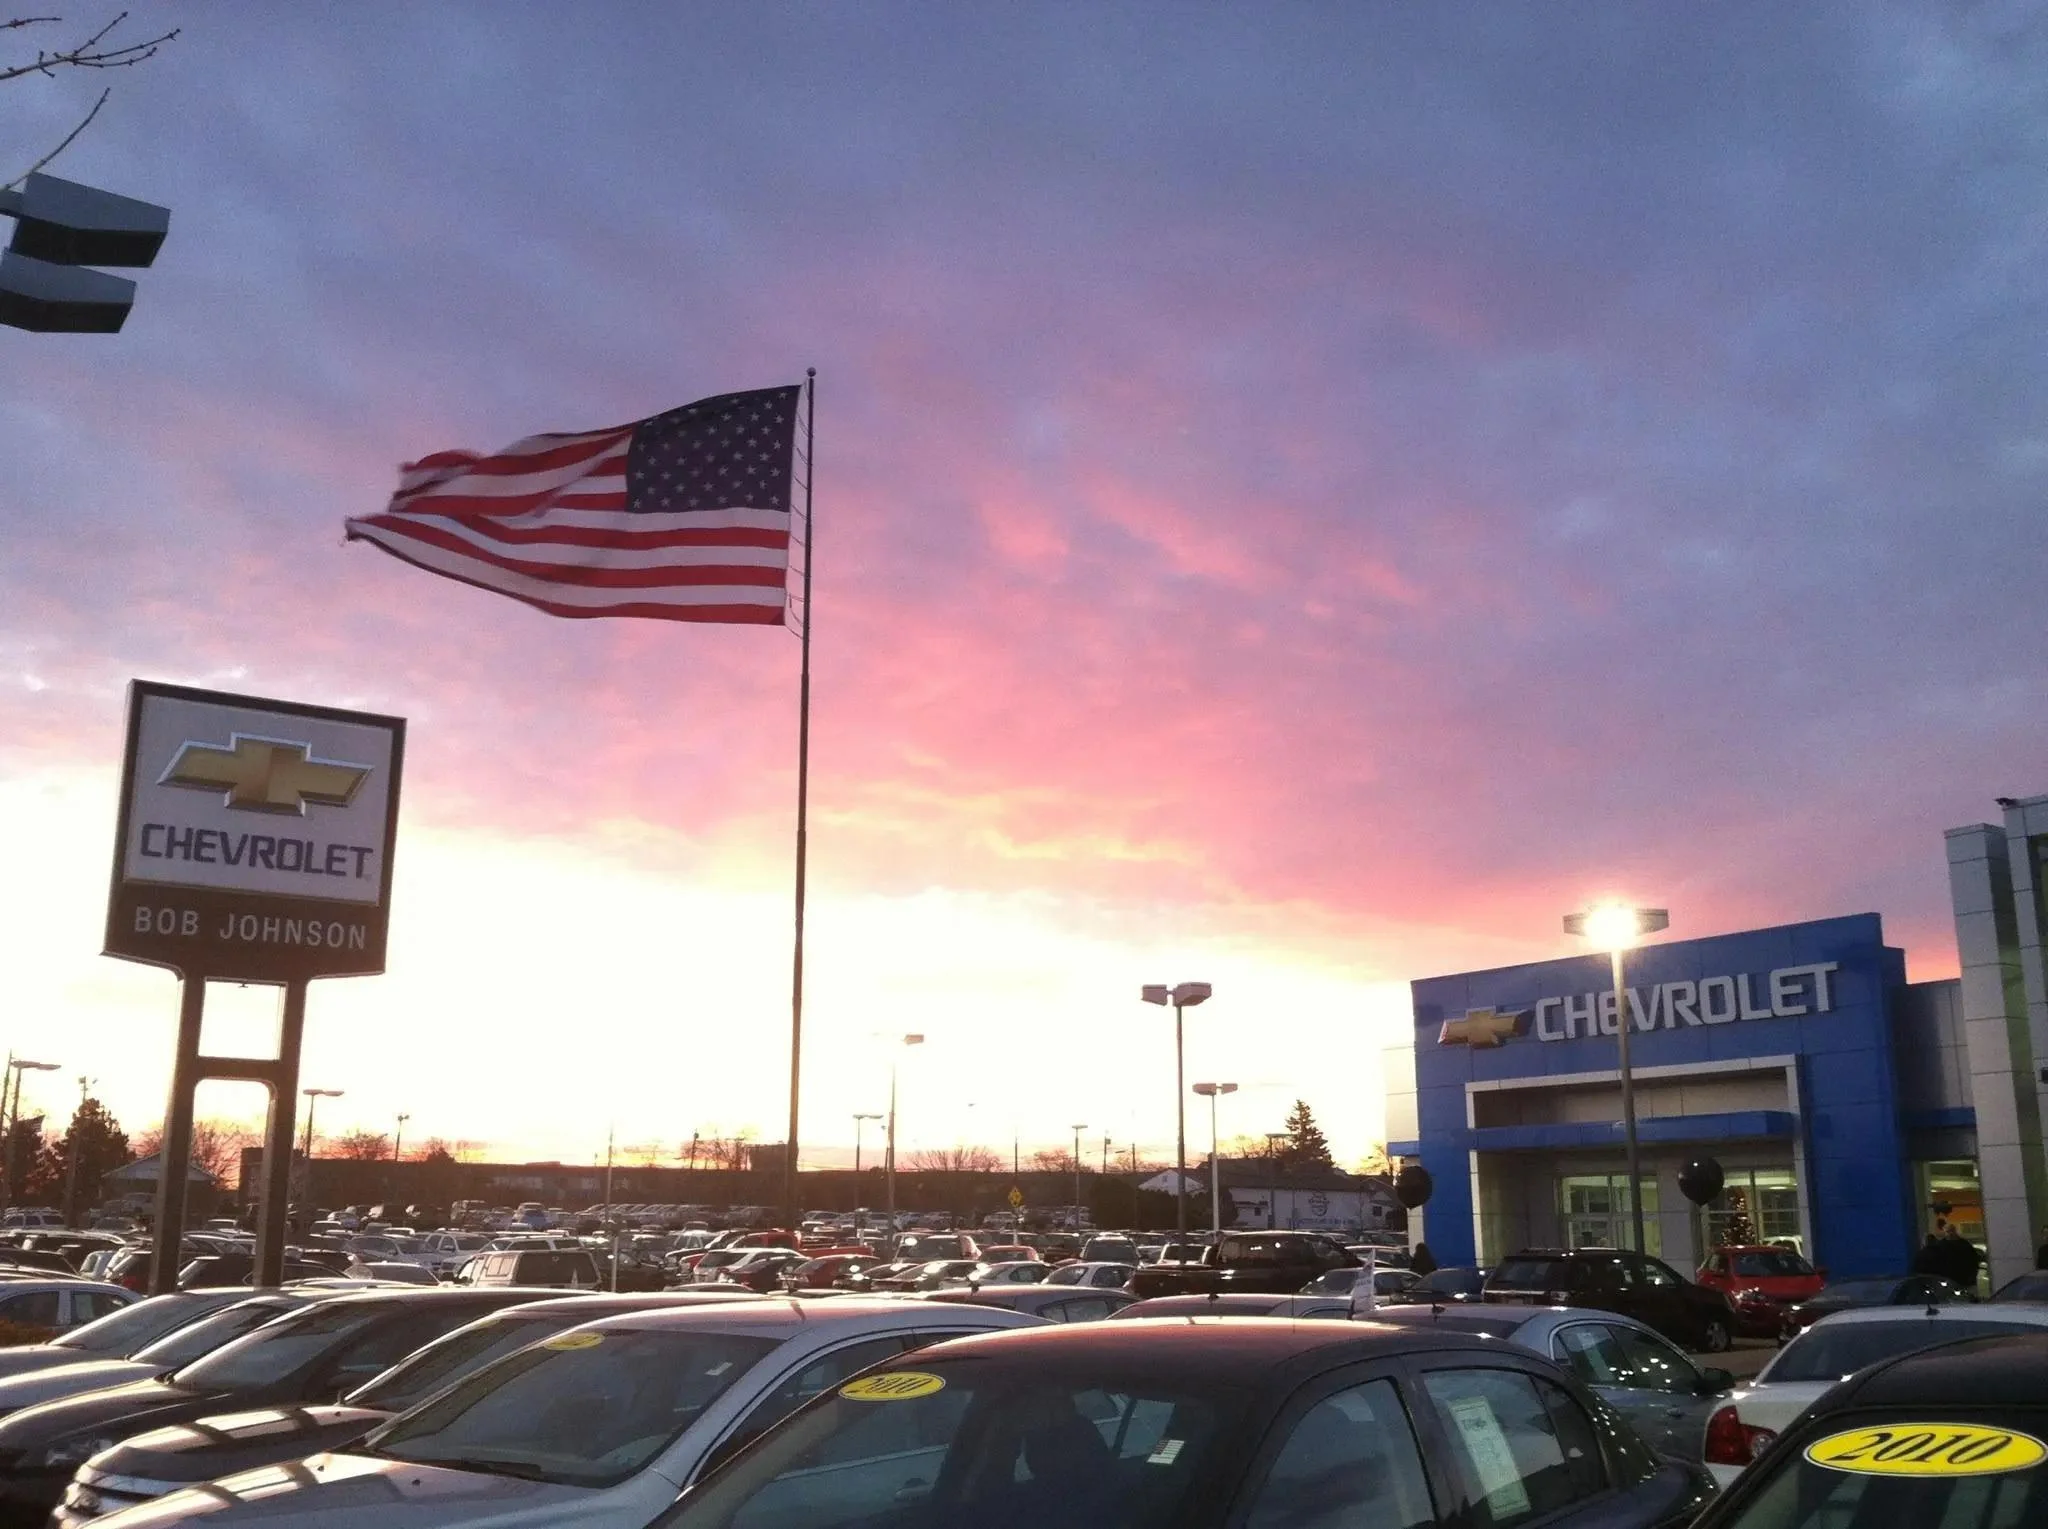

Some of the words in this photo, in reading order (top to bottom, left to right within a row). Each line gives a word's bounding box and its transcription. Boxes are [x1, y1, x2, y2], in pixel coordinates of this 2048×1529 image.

[140, 823, 374, 879] CHEVROLET
[134, 906, 199, 936] BOB
[219, 913, 367, 950] JOHNSON
[1536, 961, 1838, 1042] CHEVROLET
[1824, 1432, 2013, 1465] 2010
